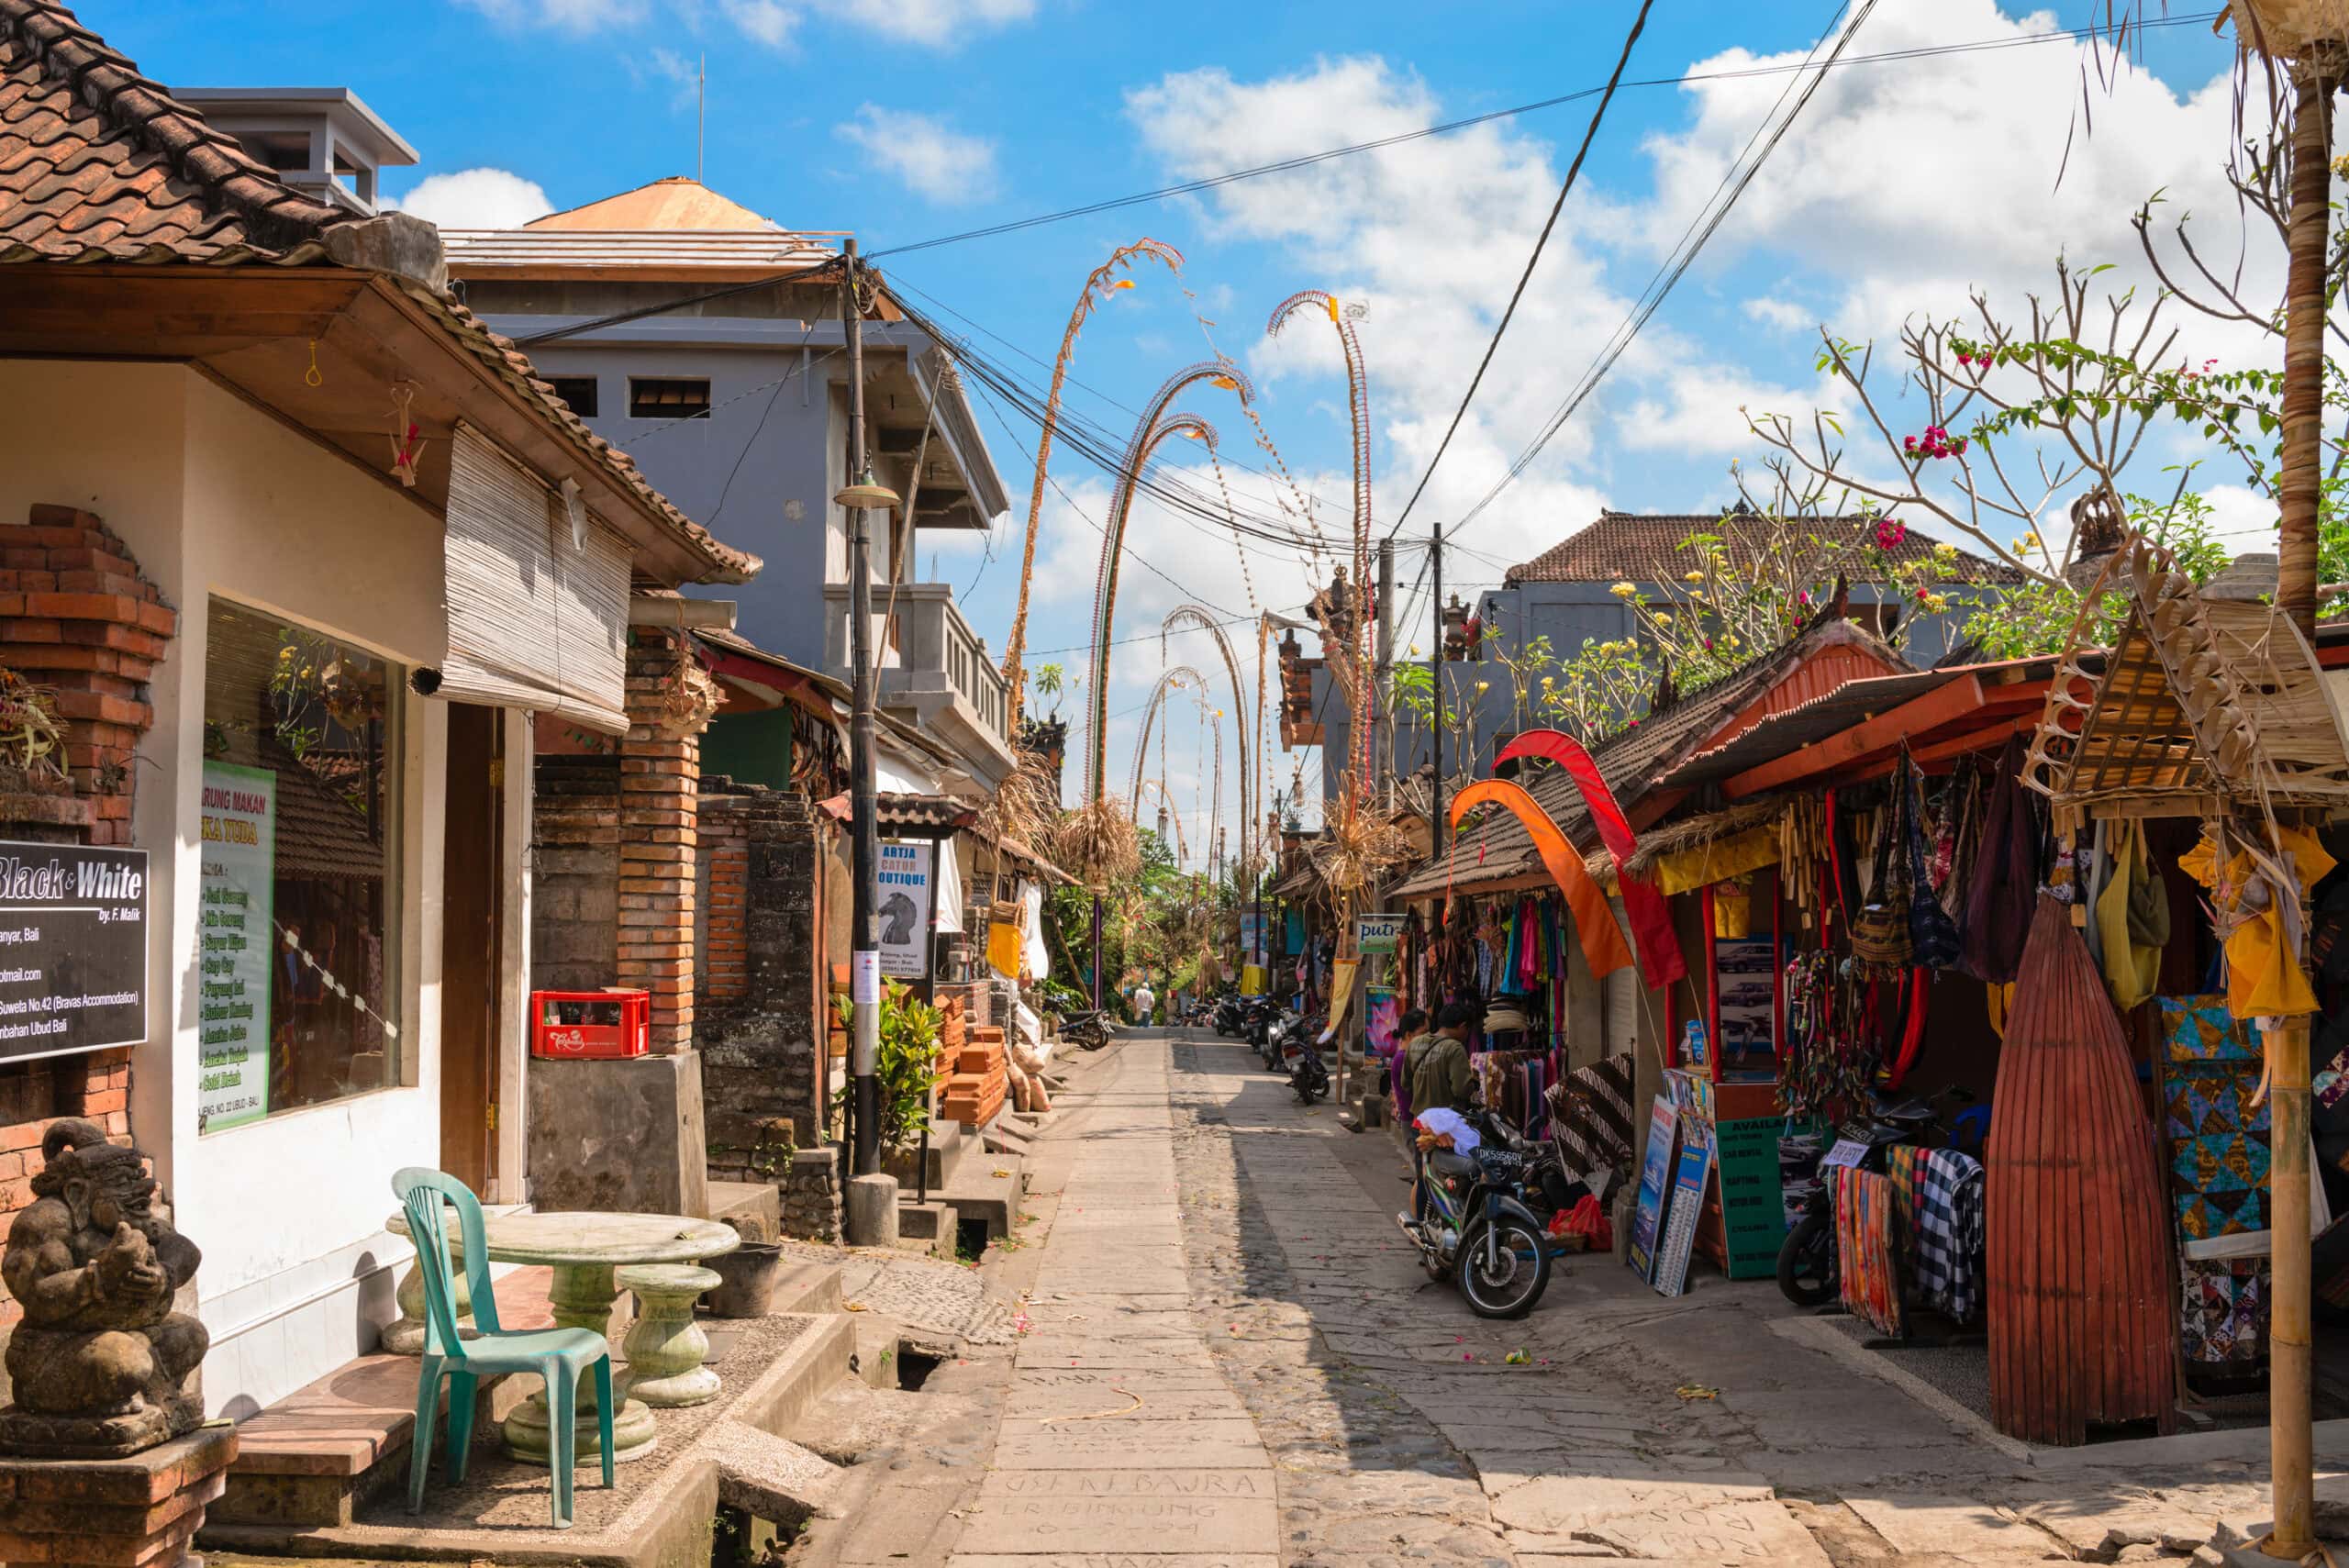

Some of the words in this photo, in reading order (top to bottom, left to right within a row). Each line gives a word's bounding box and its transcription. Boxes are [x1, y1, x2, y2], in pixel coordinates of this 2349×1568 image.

[232, 791, 266, 815] MAKAN
[223, 817, 258, 846] YUDA
[883, 846, 916, 859] ARTJA
[881, 859, 917, 872] CATUR
[65, 872, 76, 890] &
[78, 862, 141, 899] White
[112, 907, 119, 921] F.
[120, 907, 140, 921] Malik
[24, 928, 39, 941] Bali
[28, 996, 51, 1013] No.42
[53, 995, 82, 1013] (Bravas
[82, 991, 139, 1007] Accommodation)
[30, 1019, 50, 1036] Ubud
[53, 1018, 67, 1033] Bali
